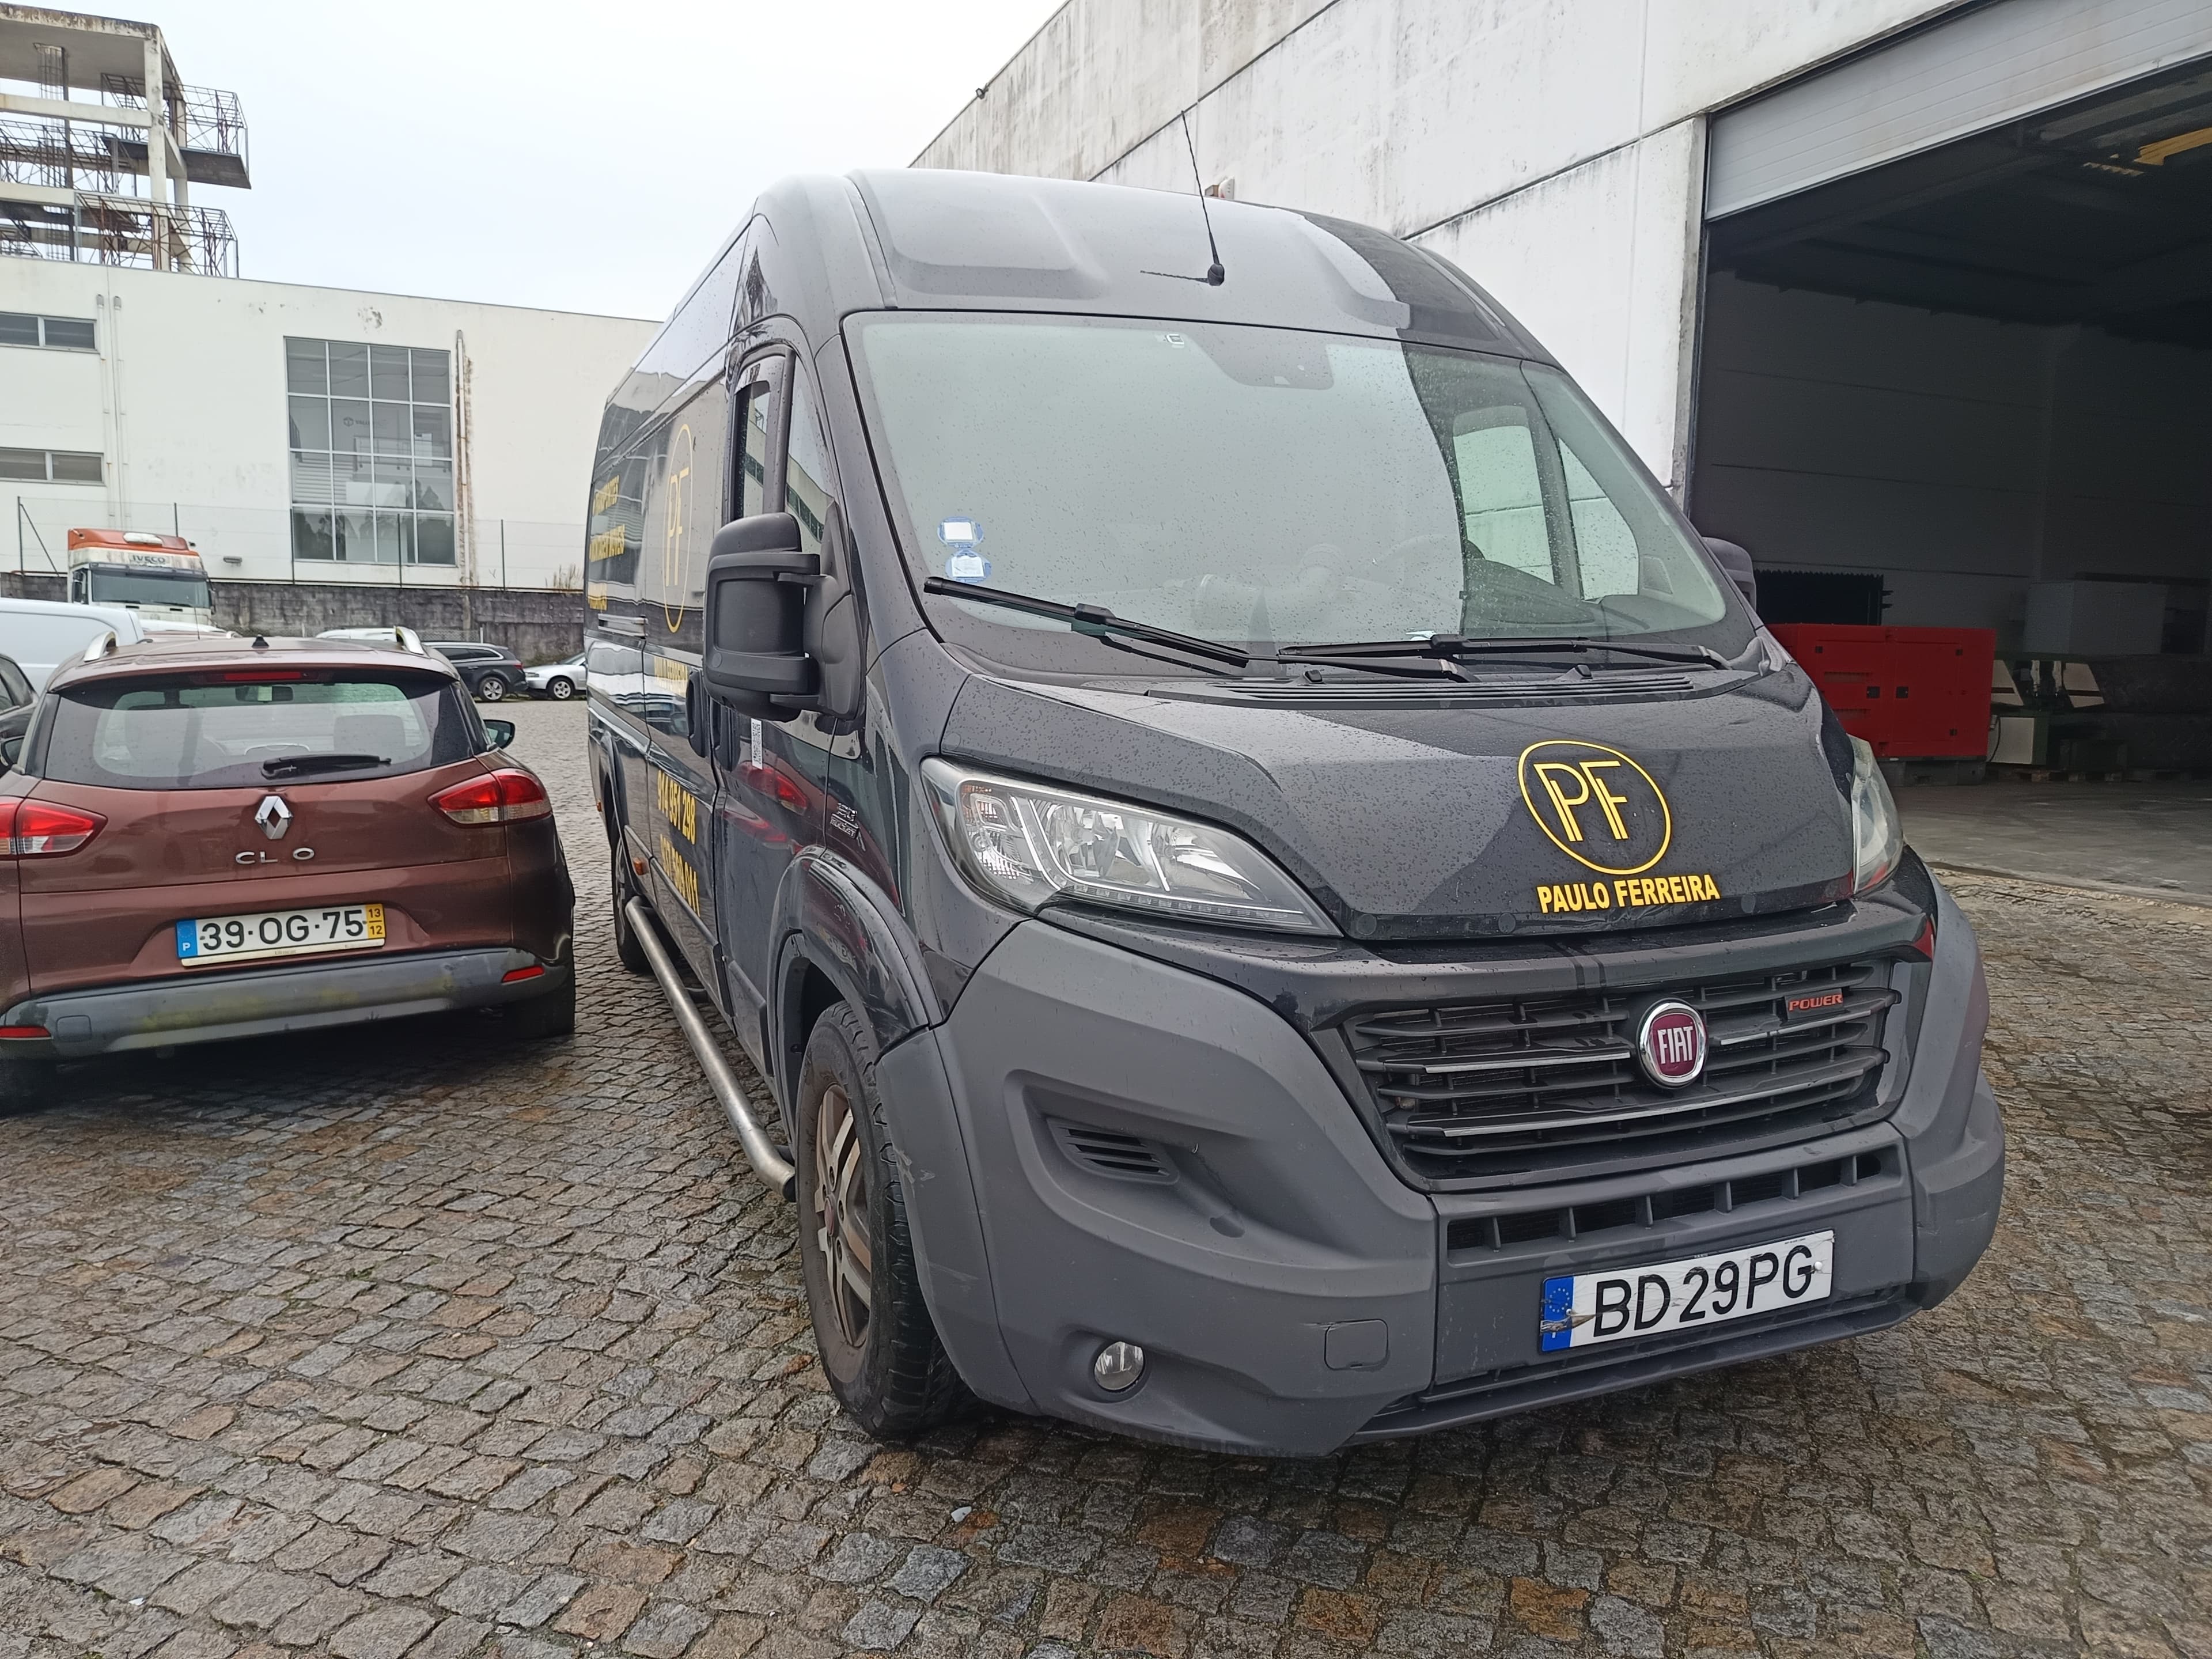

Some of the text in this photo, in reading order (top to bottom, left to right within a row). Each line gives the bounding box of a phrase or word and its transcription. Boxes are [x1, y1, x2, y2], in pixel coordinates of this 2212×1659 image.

[132, 555, 165, 564] IVECO
[657, 770, 696, 845] 914 951 298
[1533, 760, 1629, 842] PF
[685, 862, 700, 918] 011
[1536, 873, 1721, 914] PAULO FERREIRA
[369, 908, 381, 918] 13
[370, 925, 383, 935] 12
[183, 942, 191, 952] P
[1788, 993, 1843, 1012] POWER
[1657, 1025, 1694, 1065] FIAT
